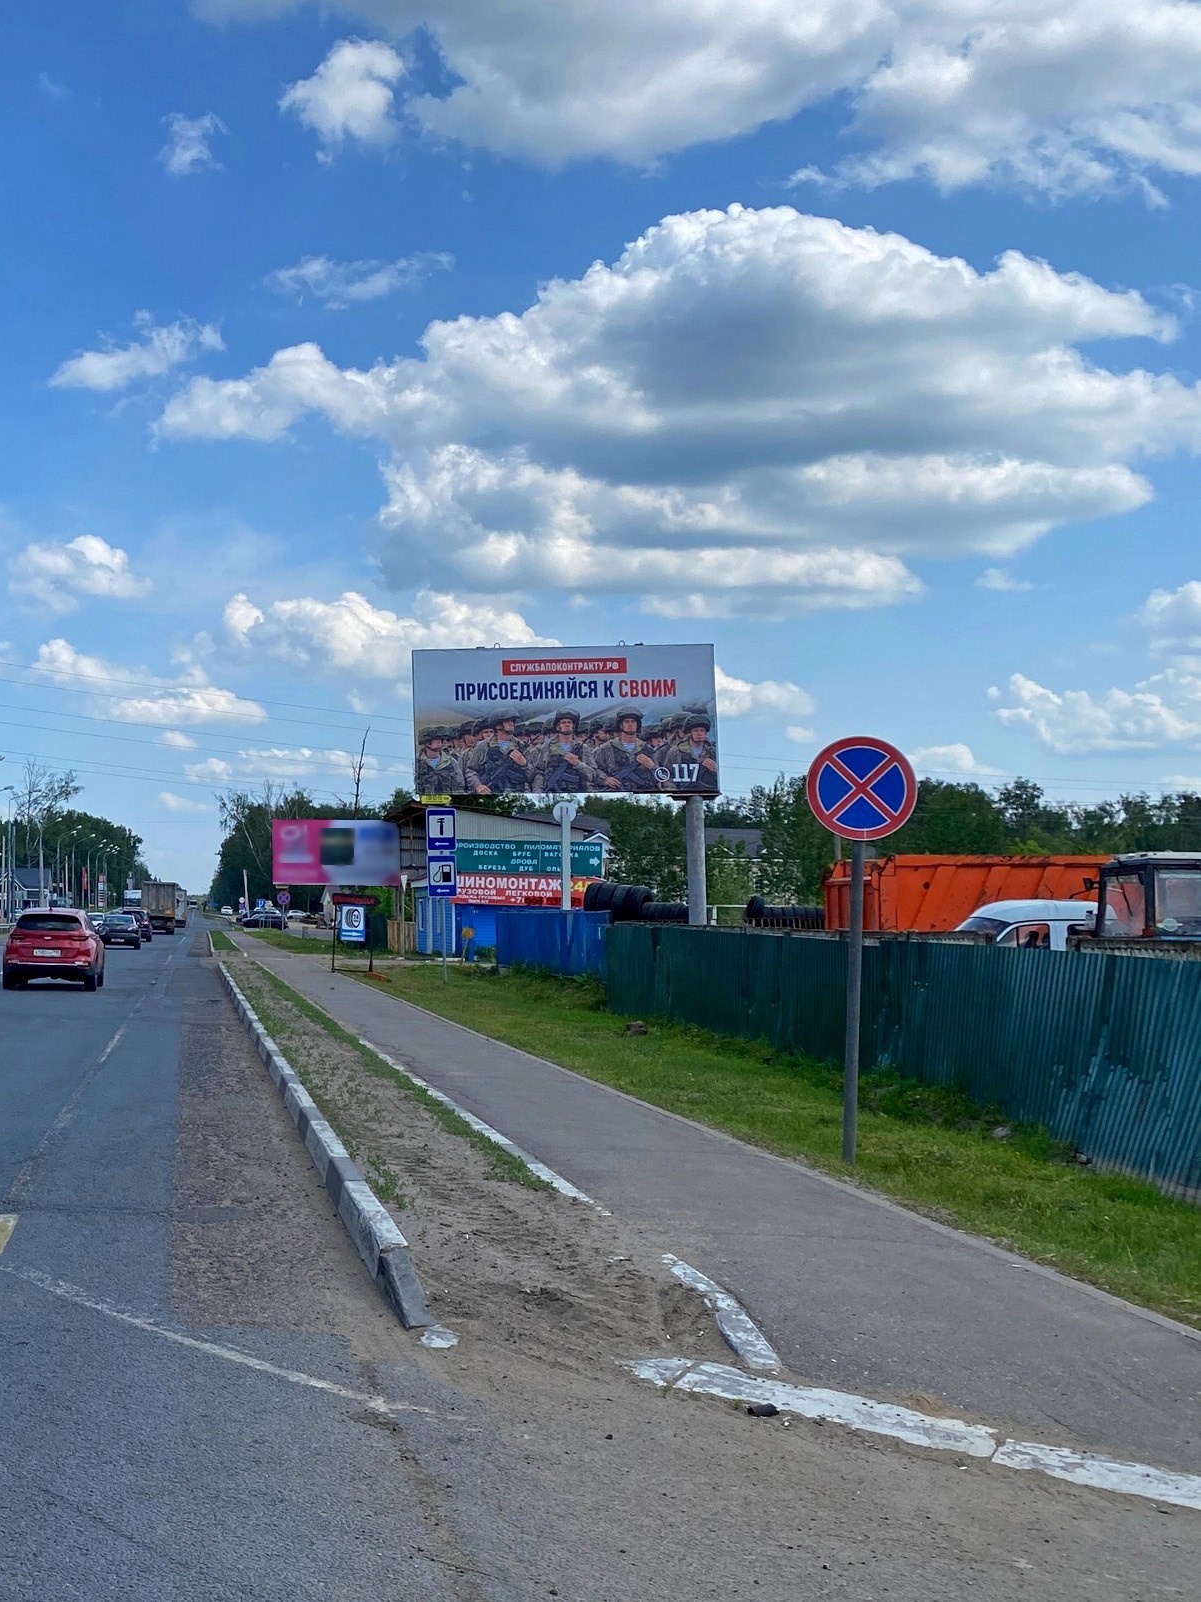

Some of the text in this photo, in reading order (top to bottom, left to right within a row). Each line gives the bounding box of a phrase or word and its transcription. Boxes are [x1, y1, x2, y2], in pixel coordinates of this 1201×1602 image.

[510, 661, 619, 673] СЛУЖБАПОКОНТРАКТУ.РФ
[455, 677, 677, 701] ПРИСОЕДИНЯЙСЯ К СВОИМ
[672, 763, 699, 782] 117
[456, 842, 601, 852] РОИЗВОДСТВО ПИЛОМАТРИАЛОВ
[456, 888, 553, 898] РУЗОВОЙ ЛЕГКОВОЙ
